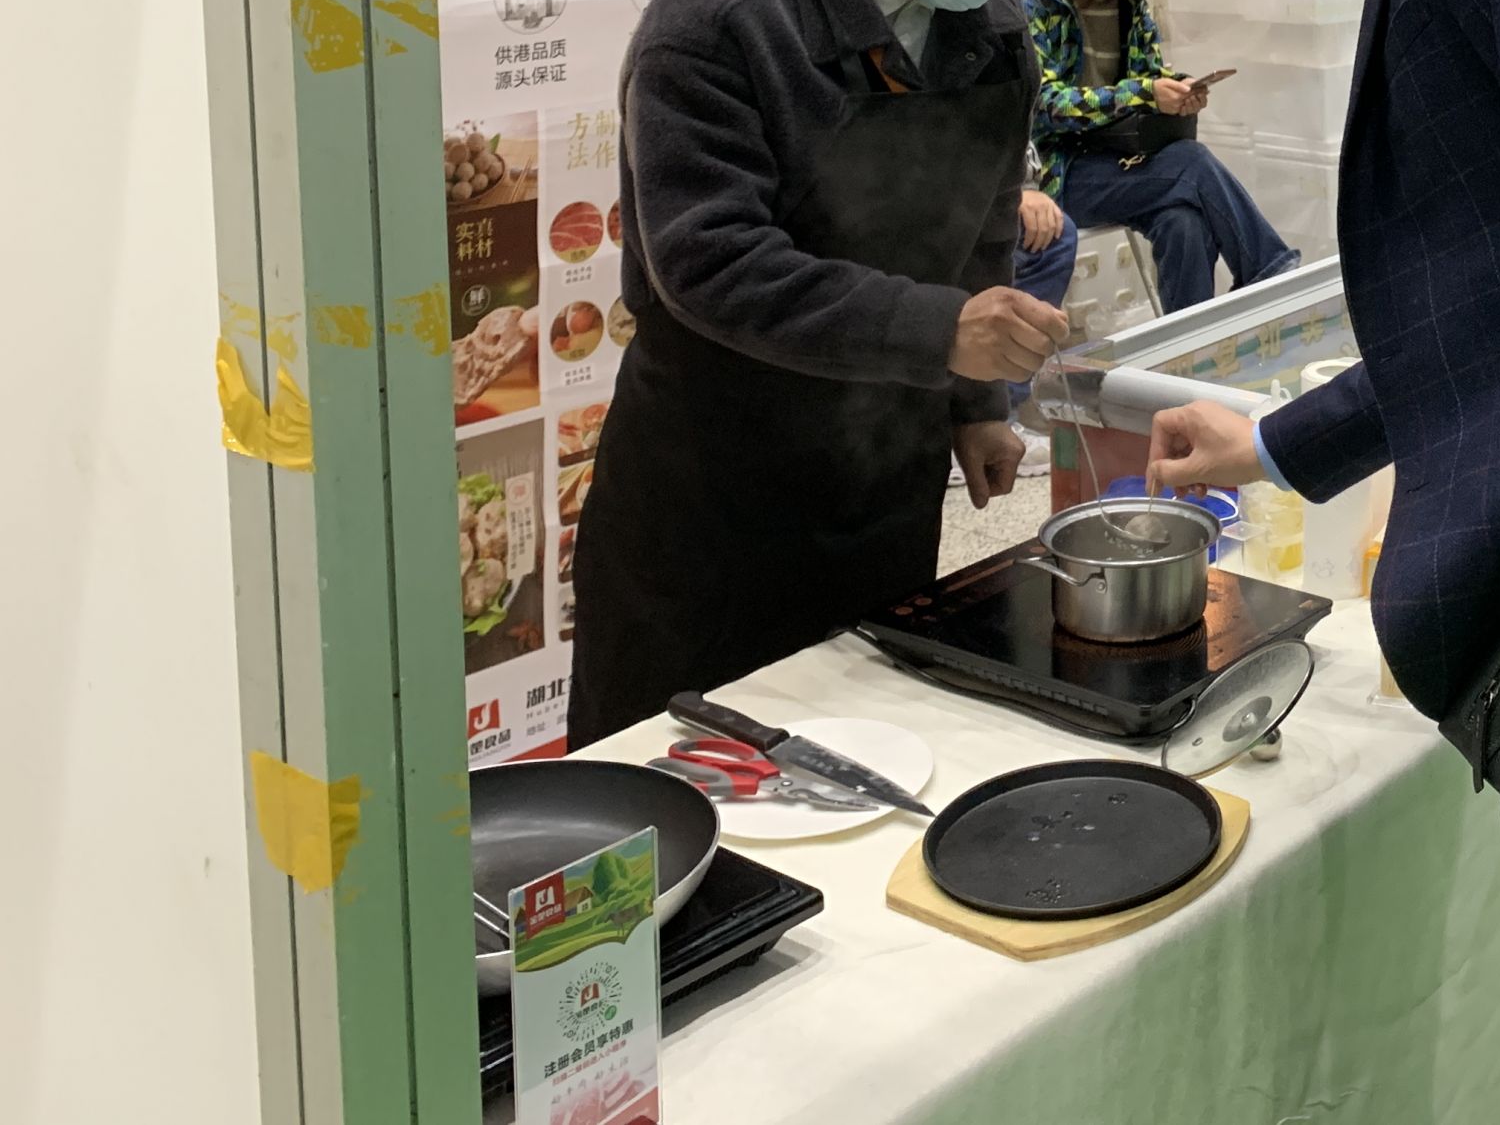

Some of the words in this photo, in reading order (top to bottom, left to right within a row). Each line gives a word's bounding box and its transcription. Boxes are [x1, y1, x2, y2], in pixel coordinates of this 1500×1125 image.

[495, 39, 567, 65] 供港品质
[495, 64, 567, 90] 源头保证
[526, 677, 573, 709] 湖北
[544, 1018, 634, 1078] 注册会员享特惠
